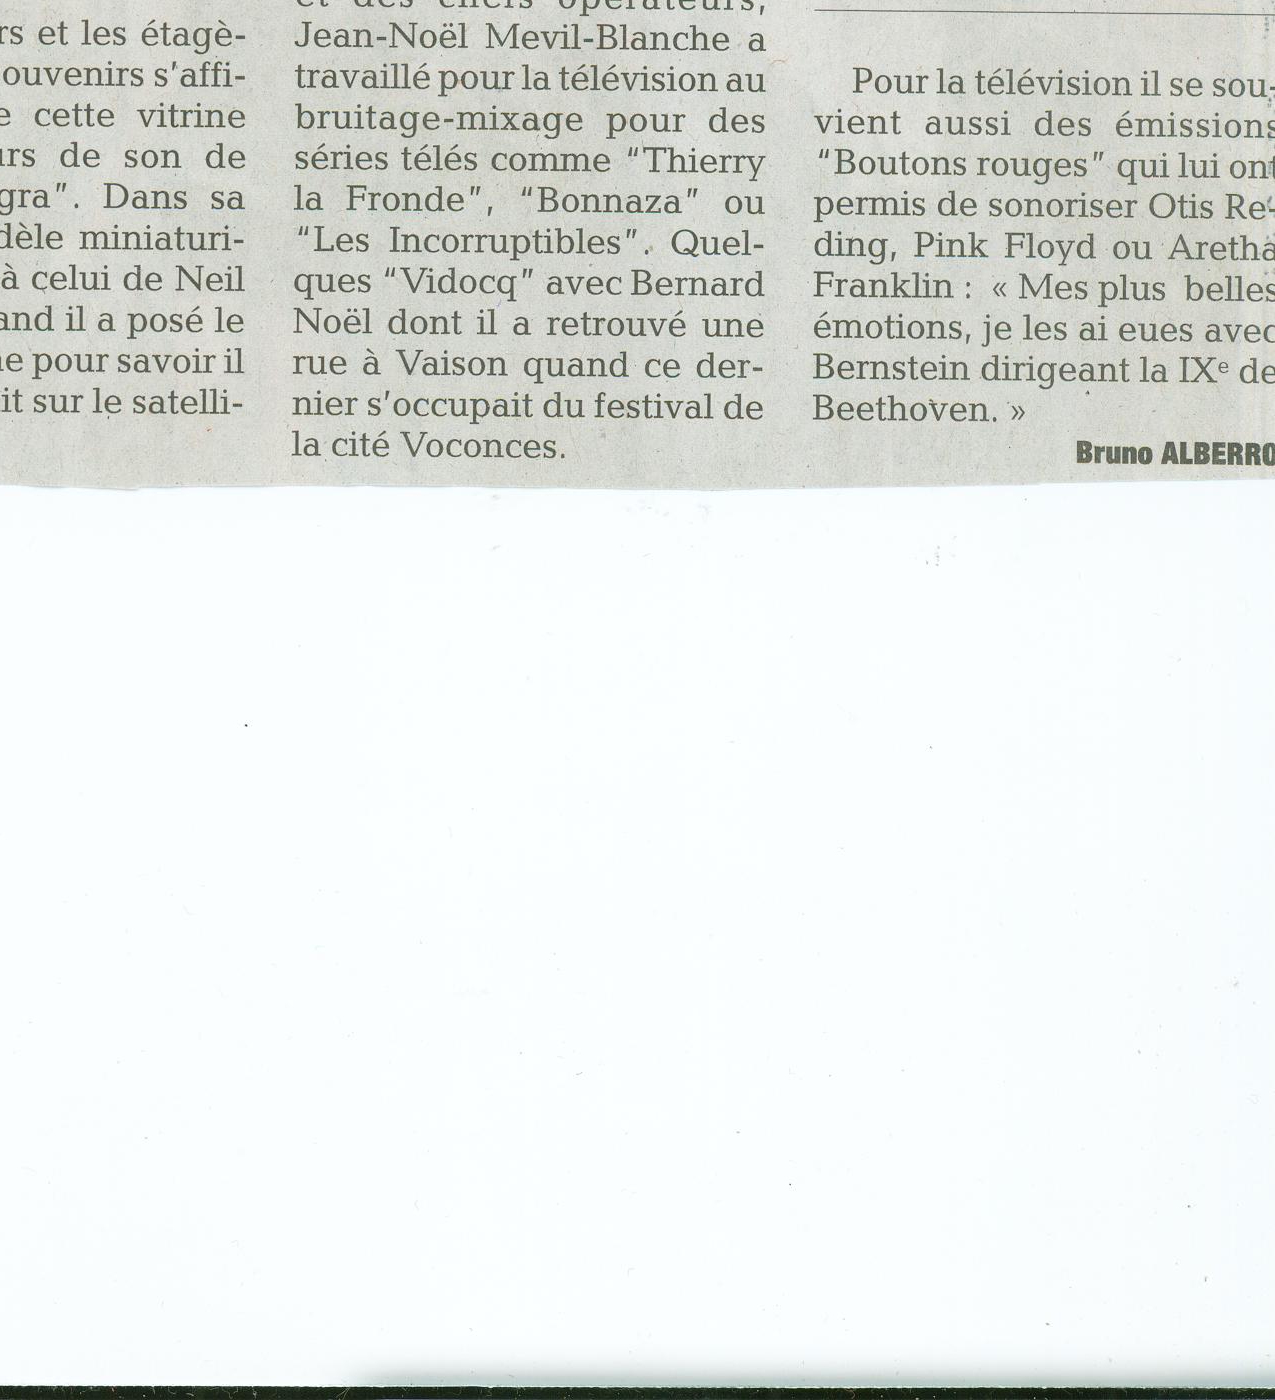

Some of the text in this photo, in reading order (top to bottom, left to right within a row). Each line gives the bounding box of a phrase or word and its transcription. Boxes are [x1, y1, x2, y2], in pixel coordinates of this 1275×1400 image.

[34, 103, 115, 128] cette
[137, 104, 246, 129] vitrine
[813, 190, 1214, 223] permis de sonoriser Otis
[79, 226, 244, 252] miniaturi-
[292, 349, 763, 384] rue à Vaison quand ce der-
[1076, 440, 1153, 465] Bruno
